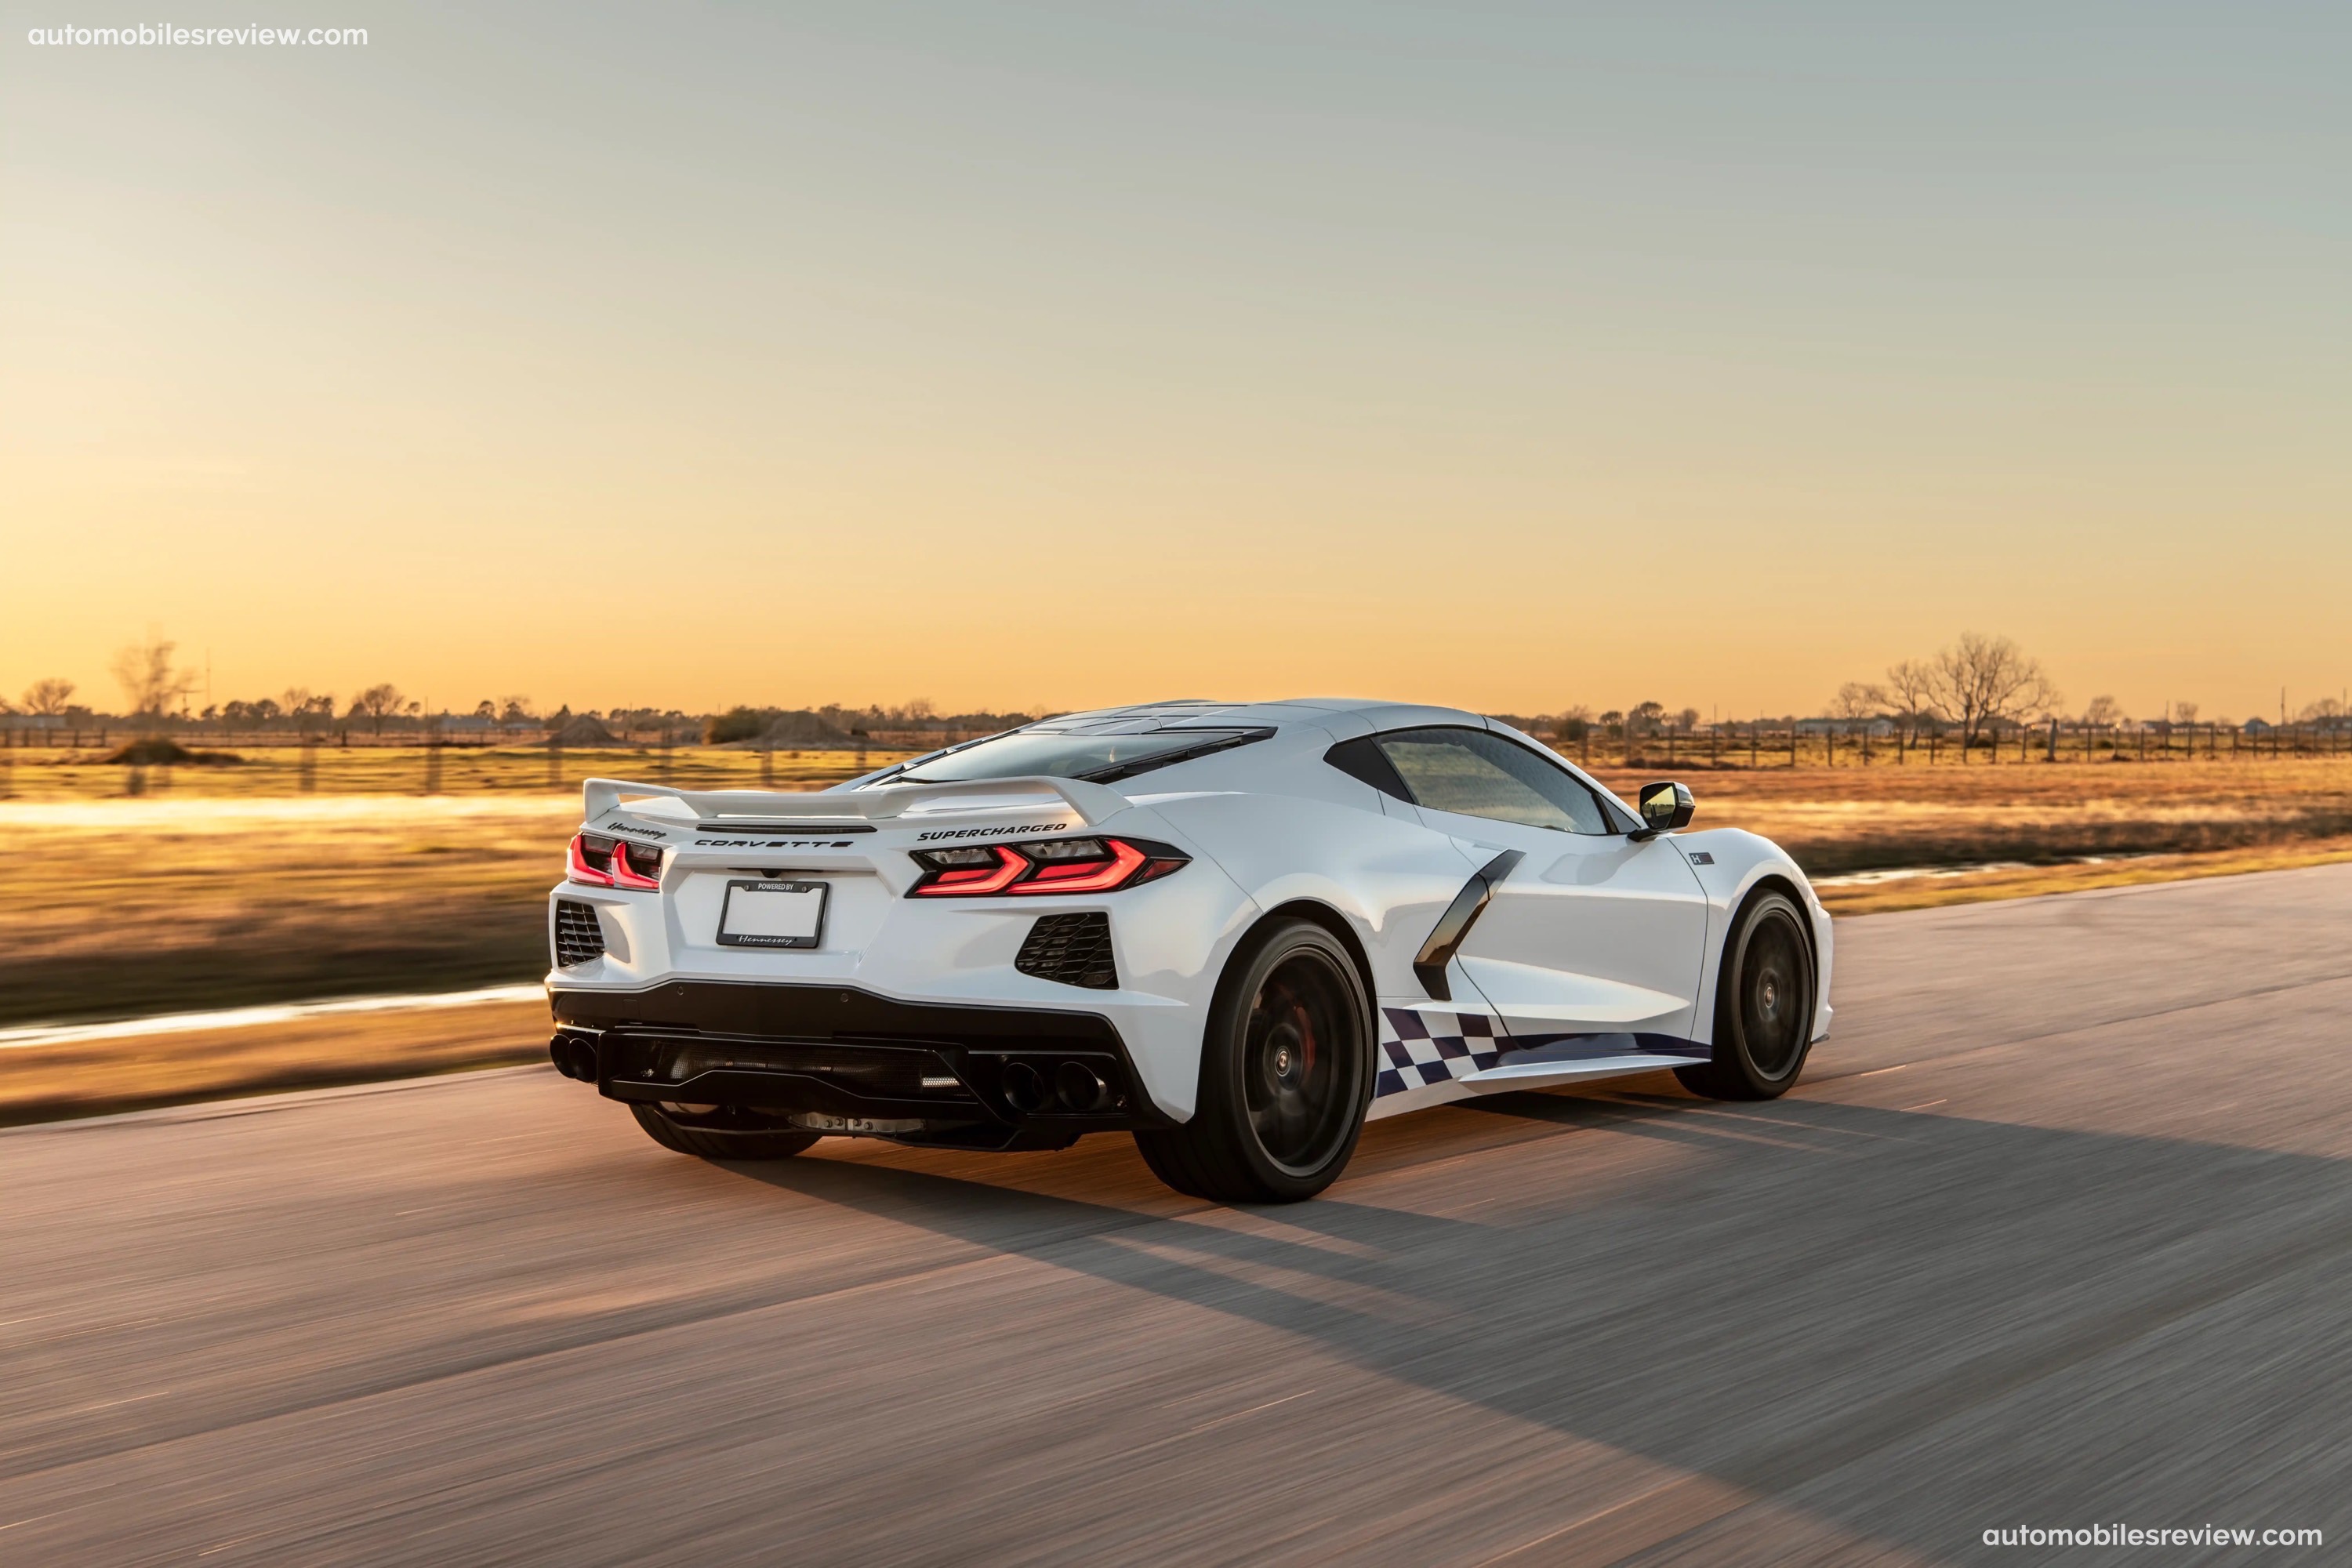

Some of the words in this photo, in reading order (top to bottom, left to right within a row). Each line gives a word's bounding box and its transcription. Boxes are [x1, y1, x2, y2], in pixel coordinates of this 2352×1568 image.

[916, 822, 1067, 842] SUPERCHARGED
[694, 839, 854, 848] CORVETTE
[739, 935, 793, 946] Hennessey
